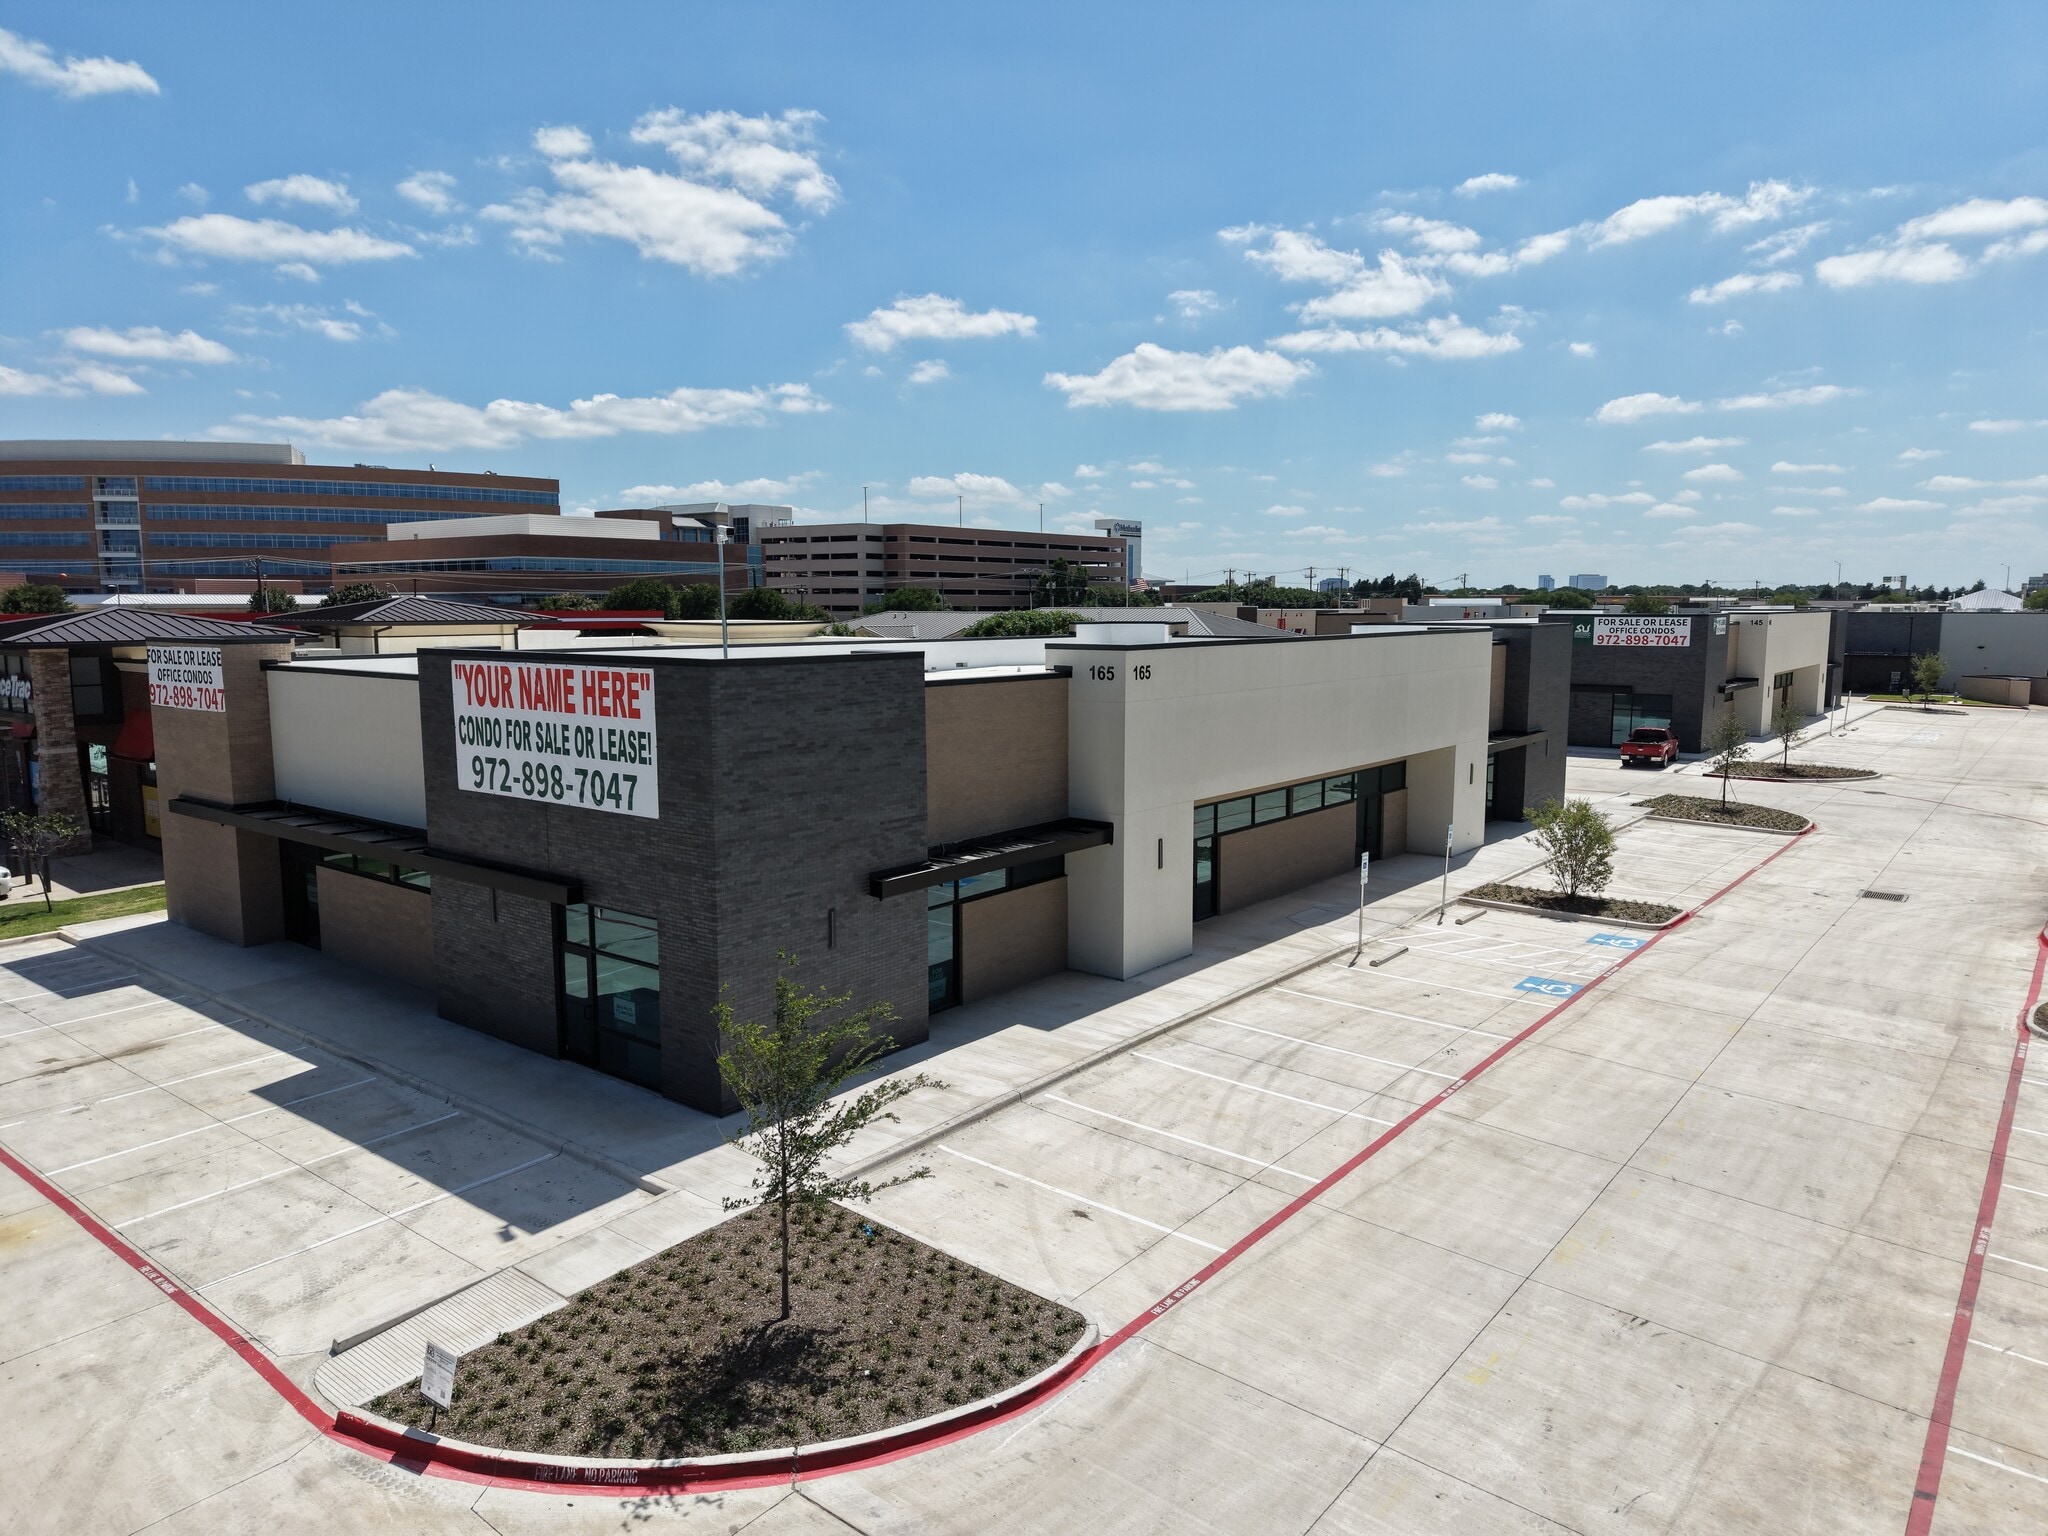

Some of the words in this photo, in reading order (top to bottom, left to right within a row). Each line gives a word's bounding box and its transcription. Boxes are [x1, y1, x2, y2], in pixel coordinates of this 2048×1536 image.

[1597, 635, 1688, 645] 972-898-7047
[147, 649, 162, 664] FOR
[163, 650, 181, 665] SALE
[184, 650, 195, 665] OR
[197, 651, 222, 666] LEASE
[158, 668, 181, 682] OFFICE
[183, 670, 213, 684] CONDOS
[1089, 665, 1115, 681] 165
[1133, 665, 1151, 681] 165
[150, 684, 225, 710] 972-898-7047
[454, 664, 514, 709] "YOUR
[518, 666, 576, 714] NAME
[582, 670, 650, 719] HERE"
[458, 715, 502, 748] CONDO
[506, 719, 532, 751] FOR
[535, 721, 570, 756] SALE
[574, 725, 595, 759] OR
[599, 728, 652, 766] LEASE!
[472, 755, 638, 811] 972-898-7047
[584, 1468, 597, 1481] NO
[599, 1468, 638, 1483] PARKING
